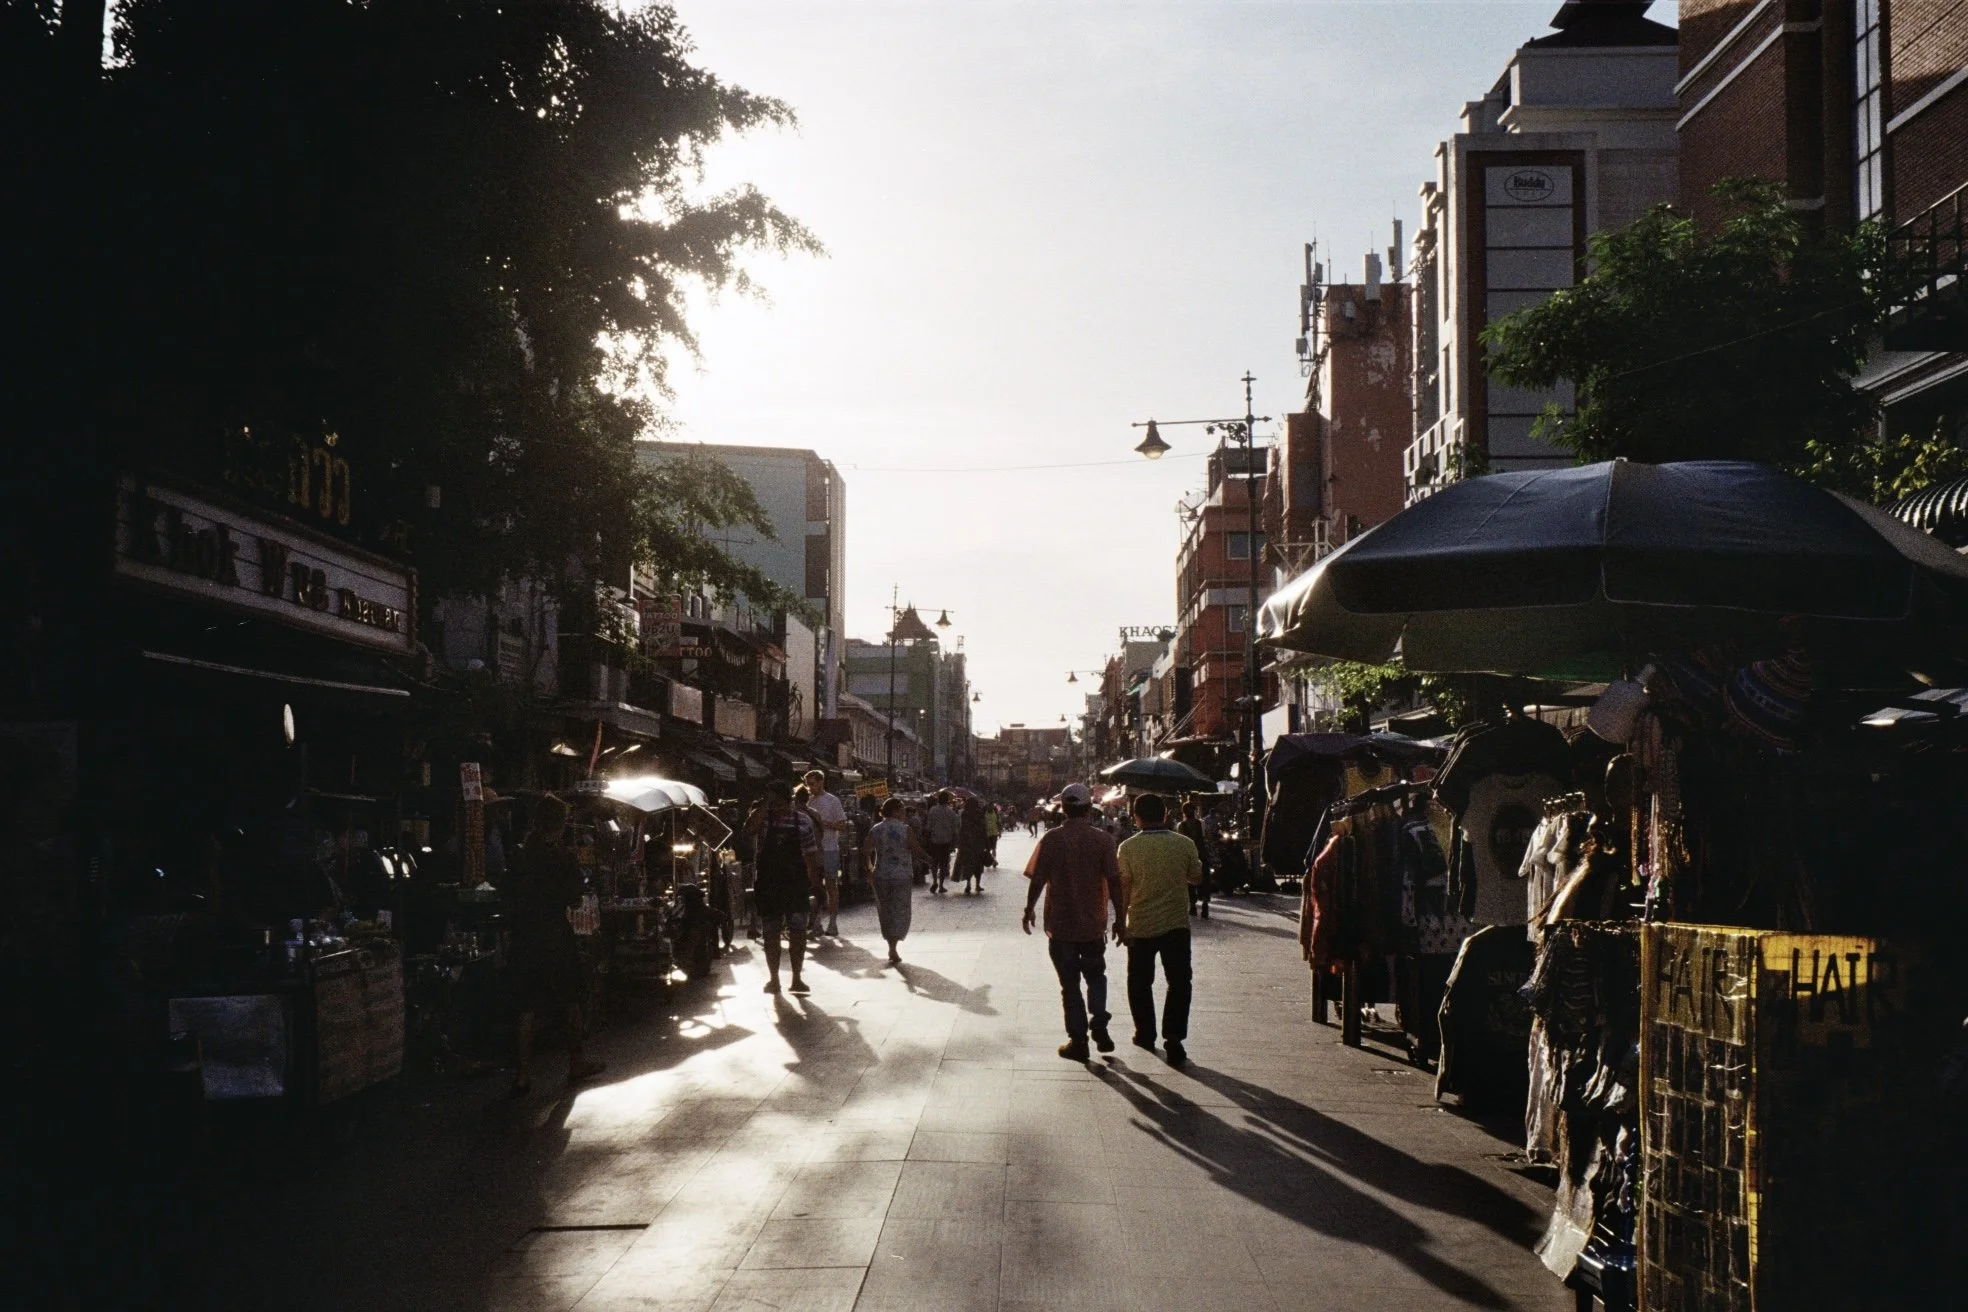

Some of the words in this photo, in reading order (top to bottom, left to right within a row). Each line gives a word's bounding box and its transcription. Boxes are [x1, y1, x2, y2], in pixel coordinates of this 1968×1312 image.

[1513, 176, 1546, 189] Buddy
[642, 611, 679, 620] TATTOO
[679, 647, 713, 658] TTOO
[1656, 940, 1736, 1025] HAIR
